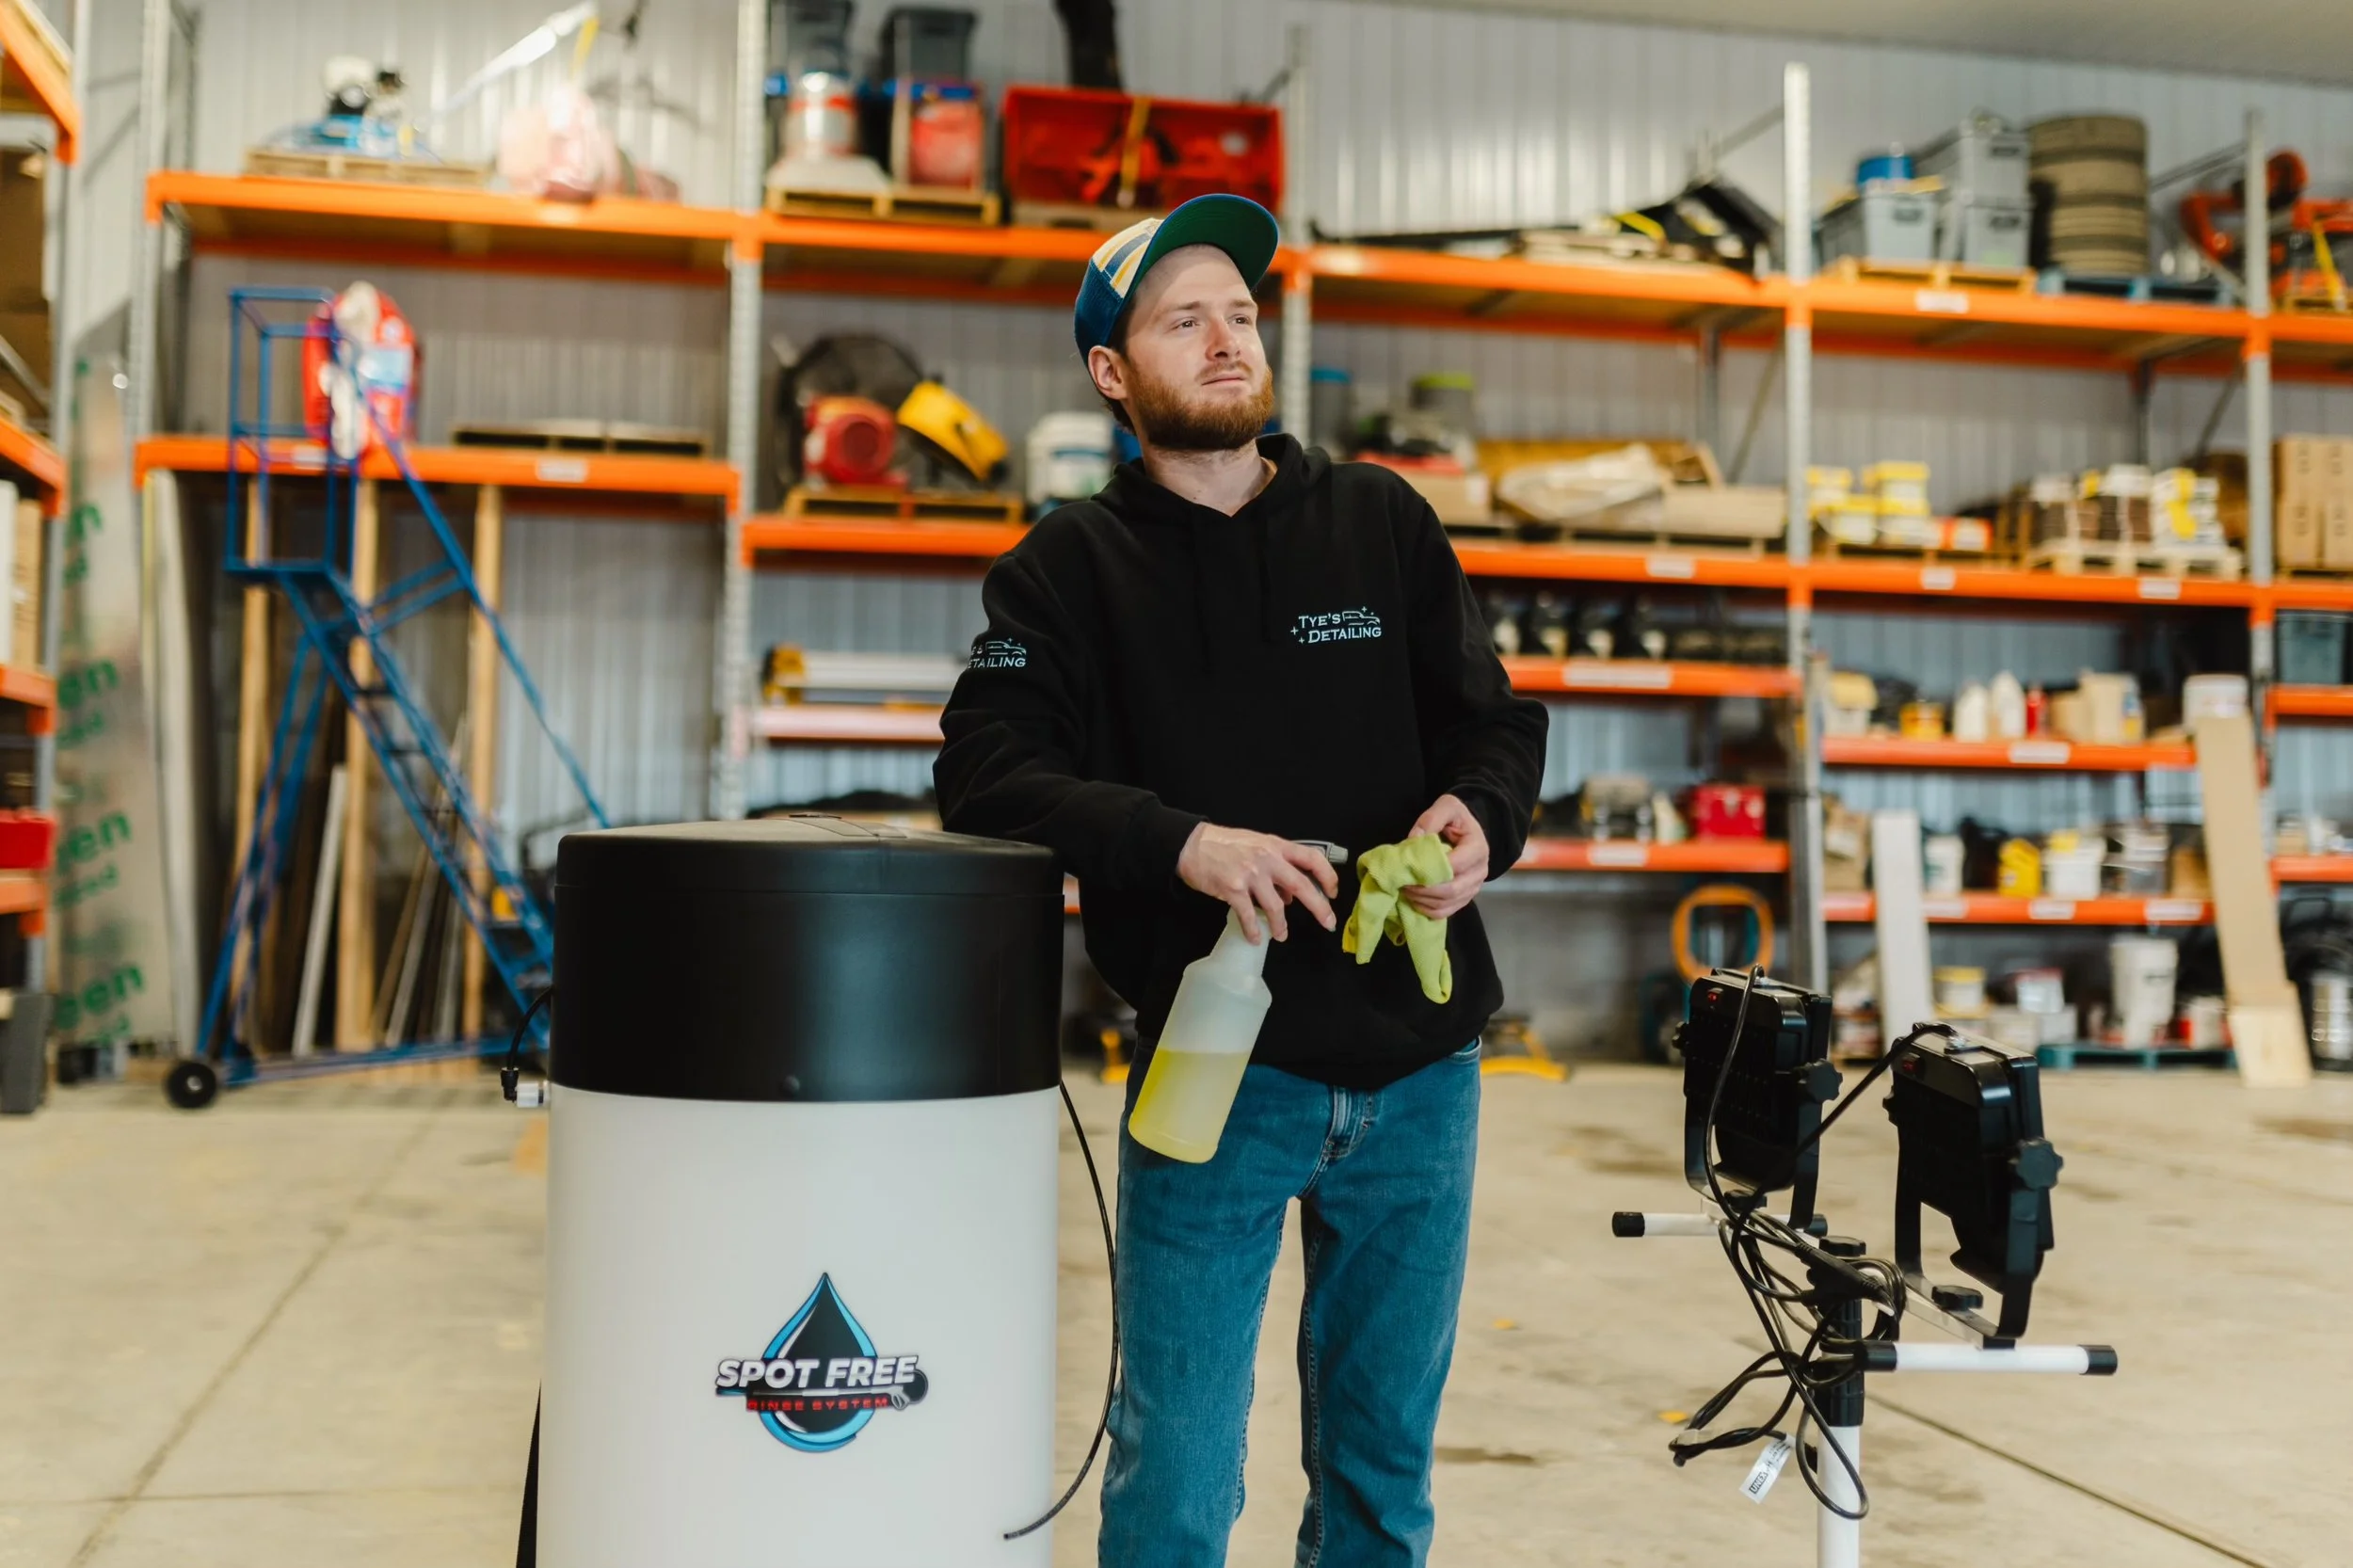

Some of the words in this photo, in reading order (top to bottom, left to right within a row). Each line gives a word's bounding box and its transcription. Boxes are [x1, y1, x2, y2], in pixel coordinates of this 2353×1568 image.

[1298, 613, 1341, 629] TYE'S
[1307, 627, 1383, 644] DETAILING
[715, 1358, 820, 1389] SPOT
[824, 1355, 919, 1388] FREE
[746, 1399, 806, 1412] RINSE
[812, 1397, 888, 1411] SYSTEM
